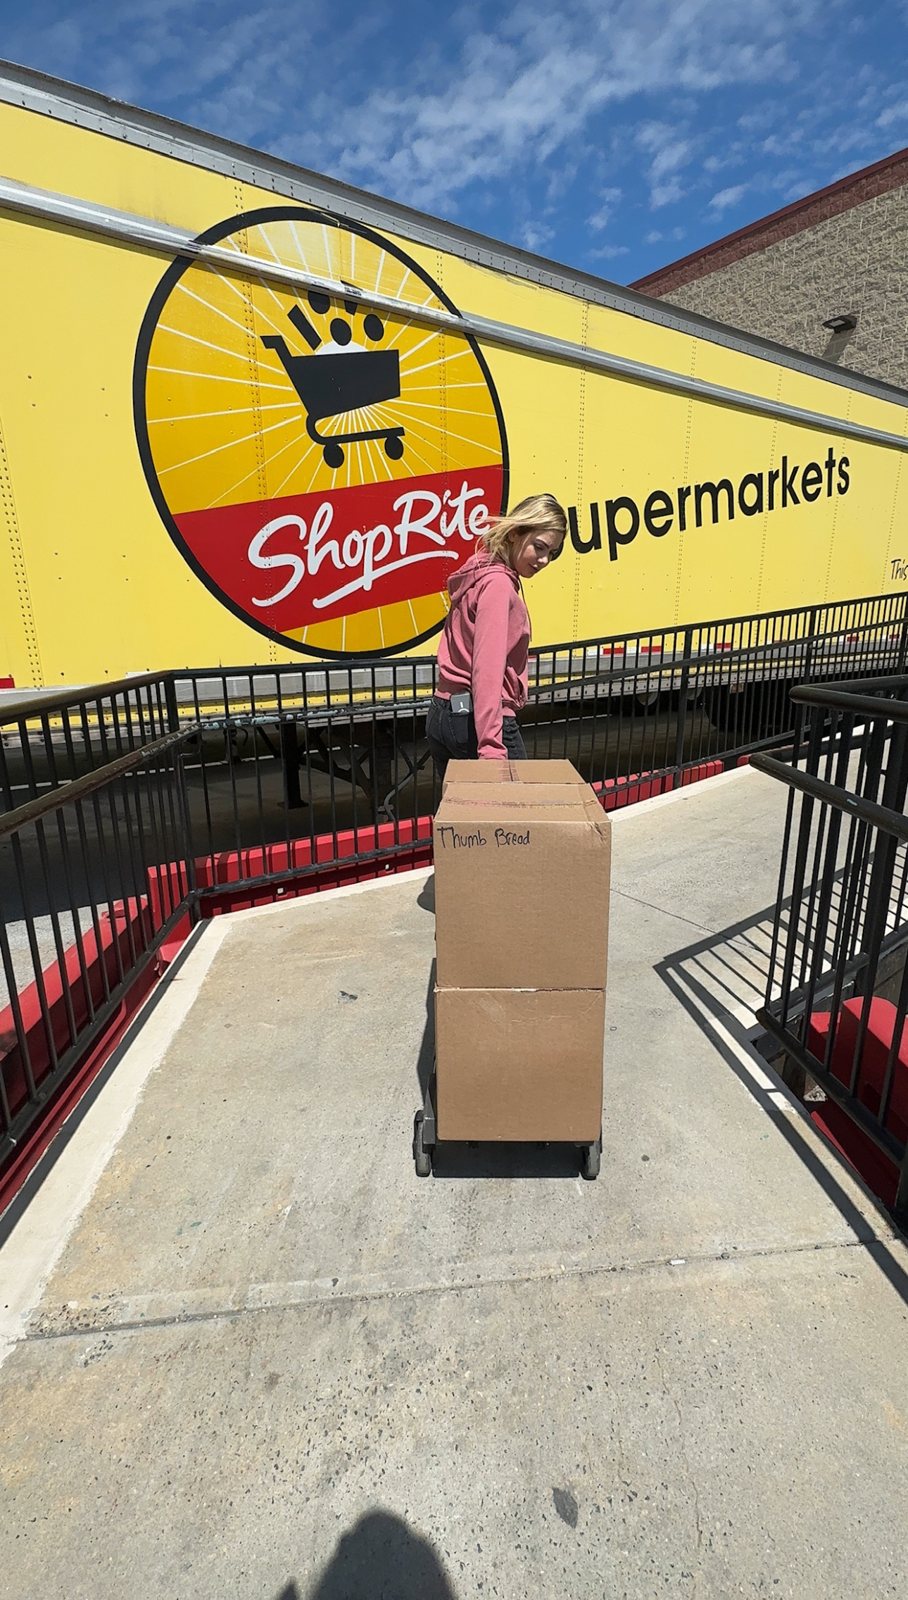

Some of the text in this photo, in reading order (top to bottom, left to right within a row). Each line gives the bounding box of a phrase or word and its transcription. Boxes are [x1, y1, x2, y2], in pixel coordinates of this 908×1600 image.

[568, 447, 850, 561] upermarkets
[437, 826, 531, 849] Thumb Bread
